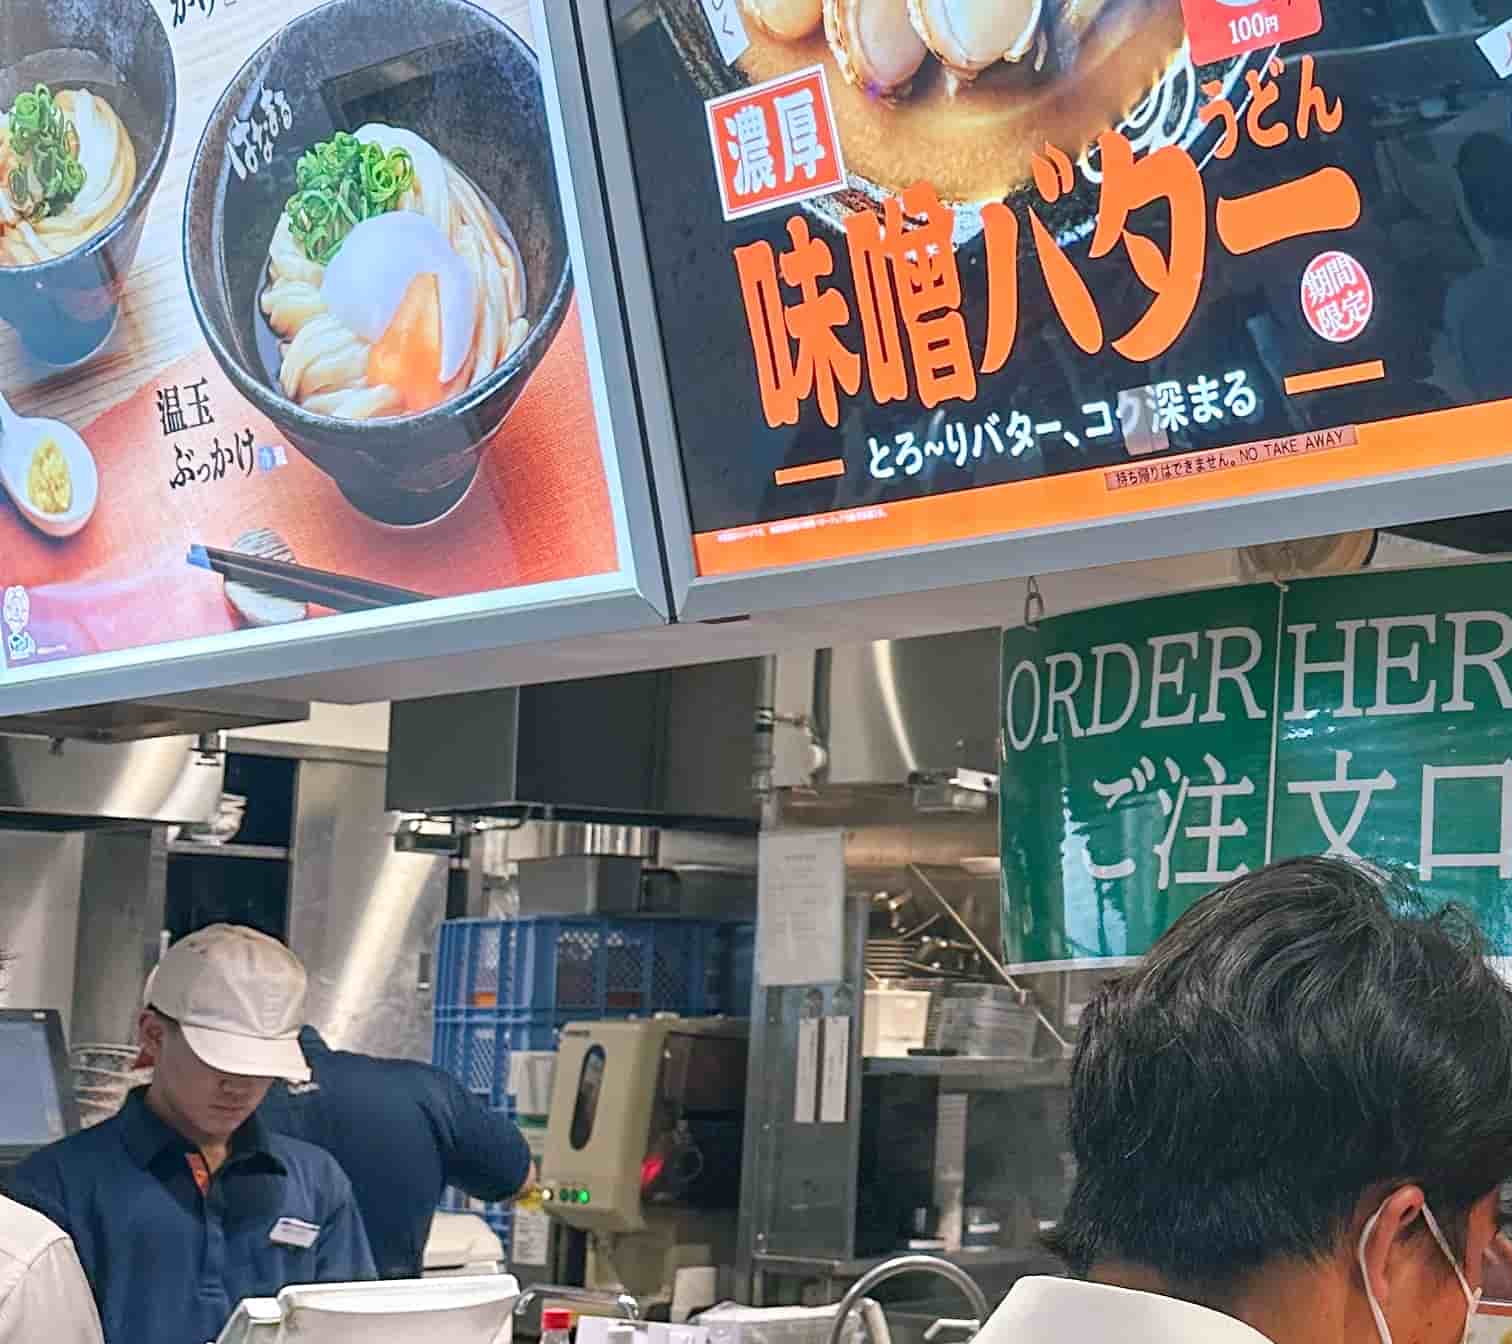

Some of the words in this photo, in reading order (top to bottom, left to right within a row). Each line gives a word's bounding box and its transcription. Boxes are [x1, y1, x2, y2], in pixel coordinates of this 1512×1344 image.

[1228, 12, 1279, 45] 100円
[723, 79, 828, 197] 濃厚
[1200, 56, 1344, 159] うどん
[157, 376, 215, 436] 温玉
[169, 427, 255, 489] ぶっかけ
[1239, 446, 1259, 463] NO
[1266, 438, 1298, 457] TAKE
[1305, 429, 1345, 449] AWAY
[1006, 625, 1266, 753] ORDER
